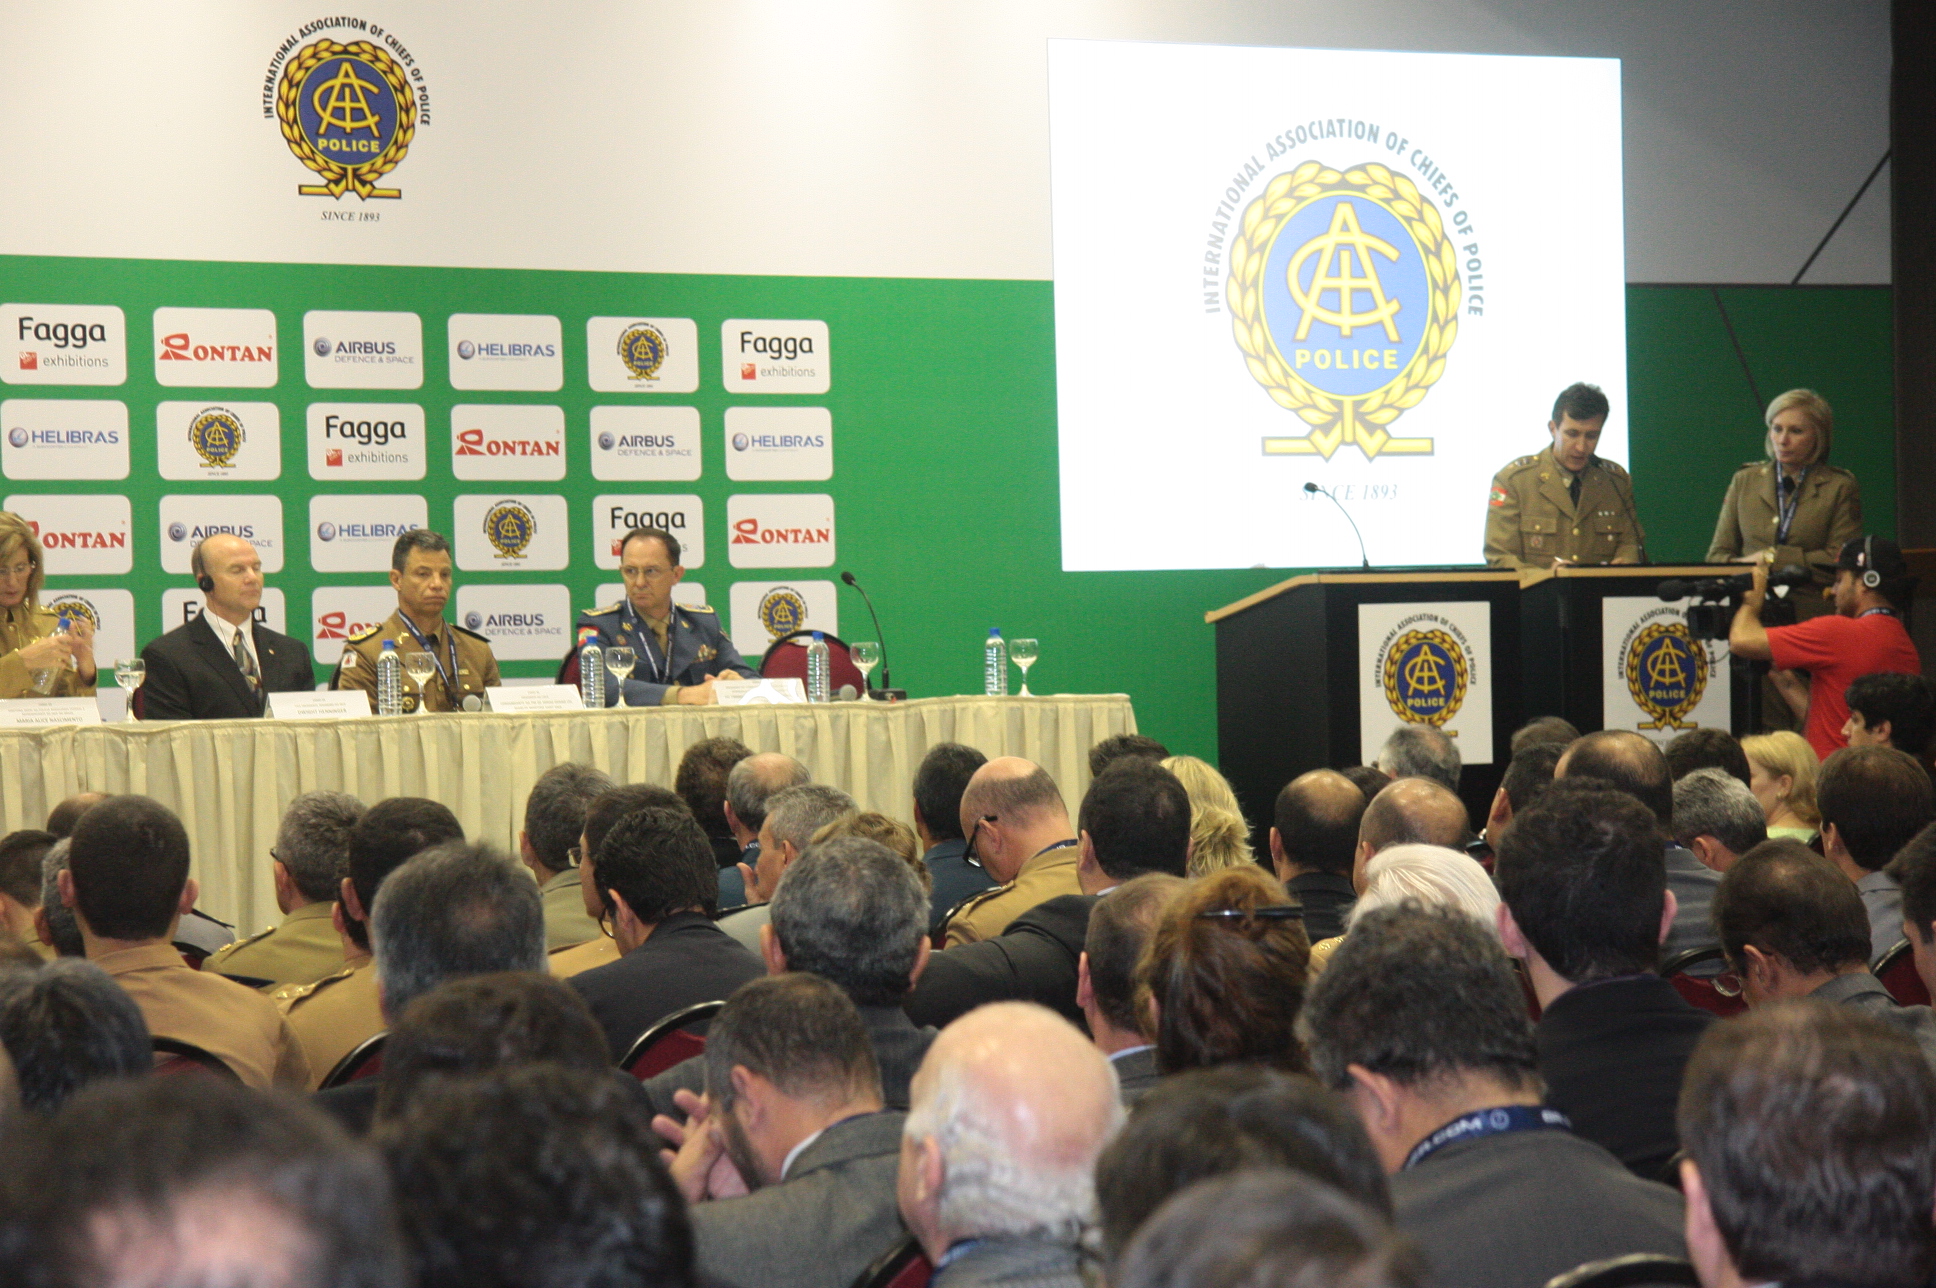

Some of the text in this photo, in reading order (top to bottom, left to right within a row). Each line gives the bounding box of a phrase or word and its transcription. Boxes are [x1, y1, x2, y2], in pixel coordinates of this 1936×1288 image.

[263, 16, 431, 126] INTERNATIONAL ASSOCIATION OF CHIEFS OF POLICE
[317, 138, 380, 152] POLICE
[320, 211, 381, 222] SINCE 1893
[1203, 118, 1485, 317] INTERNATIONAL ASSOCIATION OF CHIEFS OF POLICE
[18, 316, 106, 348] Fagga
[159, 333, 273, 362] RONTAN
[335, 341, 396, 354] AIRBUS
[478, 343, 555, 357] HELIBRAS
[740, 331, 813, 360] Fagga
[43, 354, 109, 368] exhibitions
[334, 356, 376, 364] DEFENCE
[386, 357, 414, 365] SPACE
[1295, 348, 1399, 370] POLICE
[760, 366, 815, 378] exhibitions
[32, 430, 119, 444] HELIBRAS
[325, 415, 406, 446] Fagga
[455, 429, 560, 456] RONTAN
[618, 435, 674, 448] AIRBUS
[751, 435, 824, 448] HELIBRAS
[348, 450, 408, 463] exhibitions
[617, 449, 656, 457] DEFENCE
[1363, 483, 1398, 500] 1893
[732, 518, 830, 544] RONTAN
[486, 613, 544, 627] AIRBUS
[1639, 607, 1680, 624] ASSOCIATION
[485, 628, 525, 636] DEFENCE
[535, 628, 562, 636] SPACE
[1375, 629, 1398, 688] INTERNATIONAL
[1397, 613, 1439, 630] ASSOCIATION
[1440, 617, 1449, 627] OF
[1449, 624, 1467, 646] CHIEFS
[1469, 658, 1477, 686] POLICE
[1649, 690, 1686, 699] POLICE
[1407, 698, 1445, 707] POLICE
